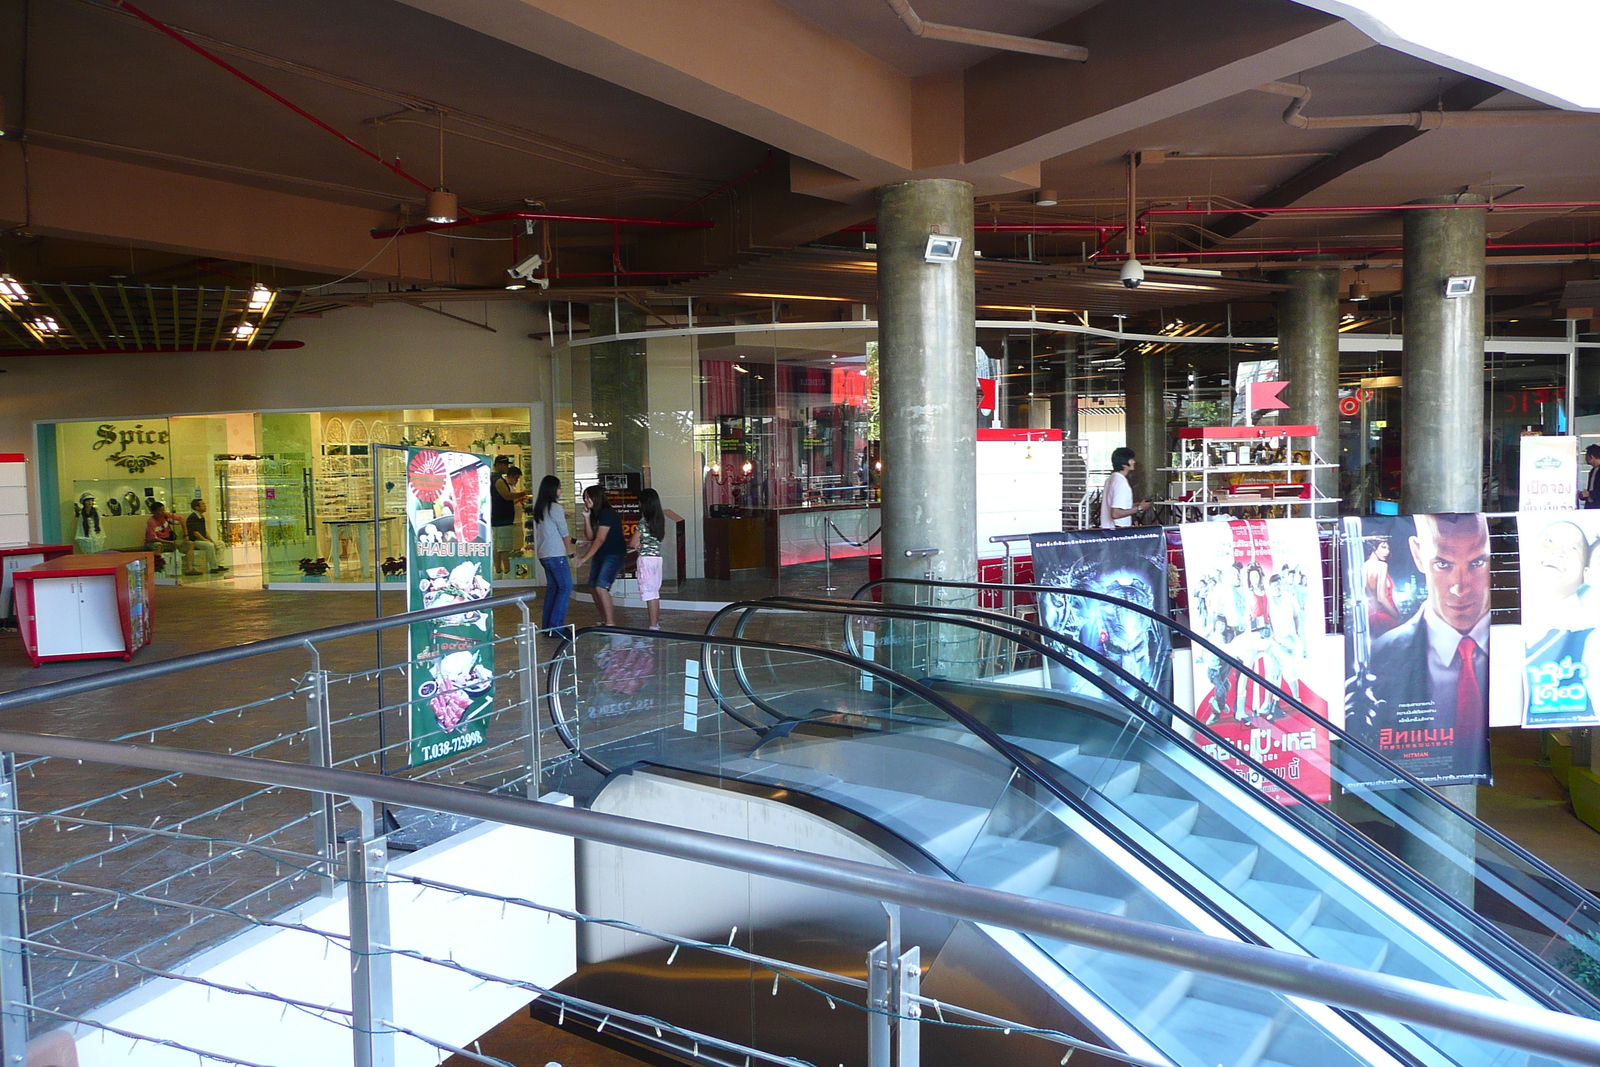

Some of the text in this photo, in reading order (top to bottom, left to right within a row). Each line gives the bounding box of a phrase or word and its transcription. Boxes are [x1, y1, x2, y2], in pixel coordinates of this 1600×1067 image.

[93, 424, 169, 453] Spice
[416, 542, 491, 556] SHABU BUFFET
